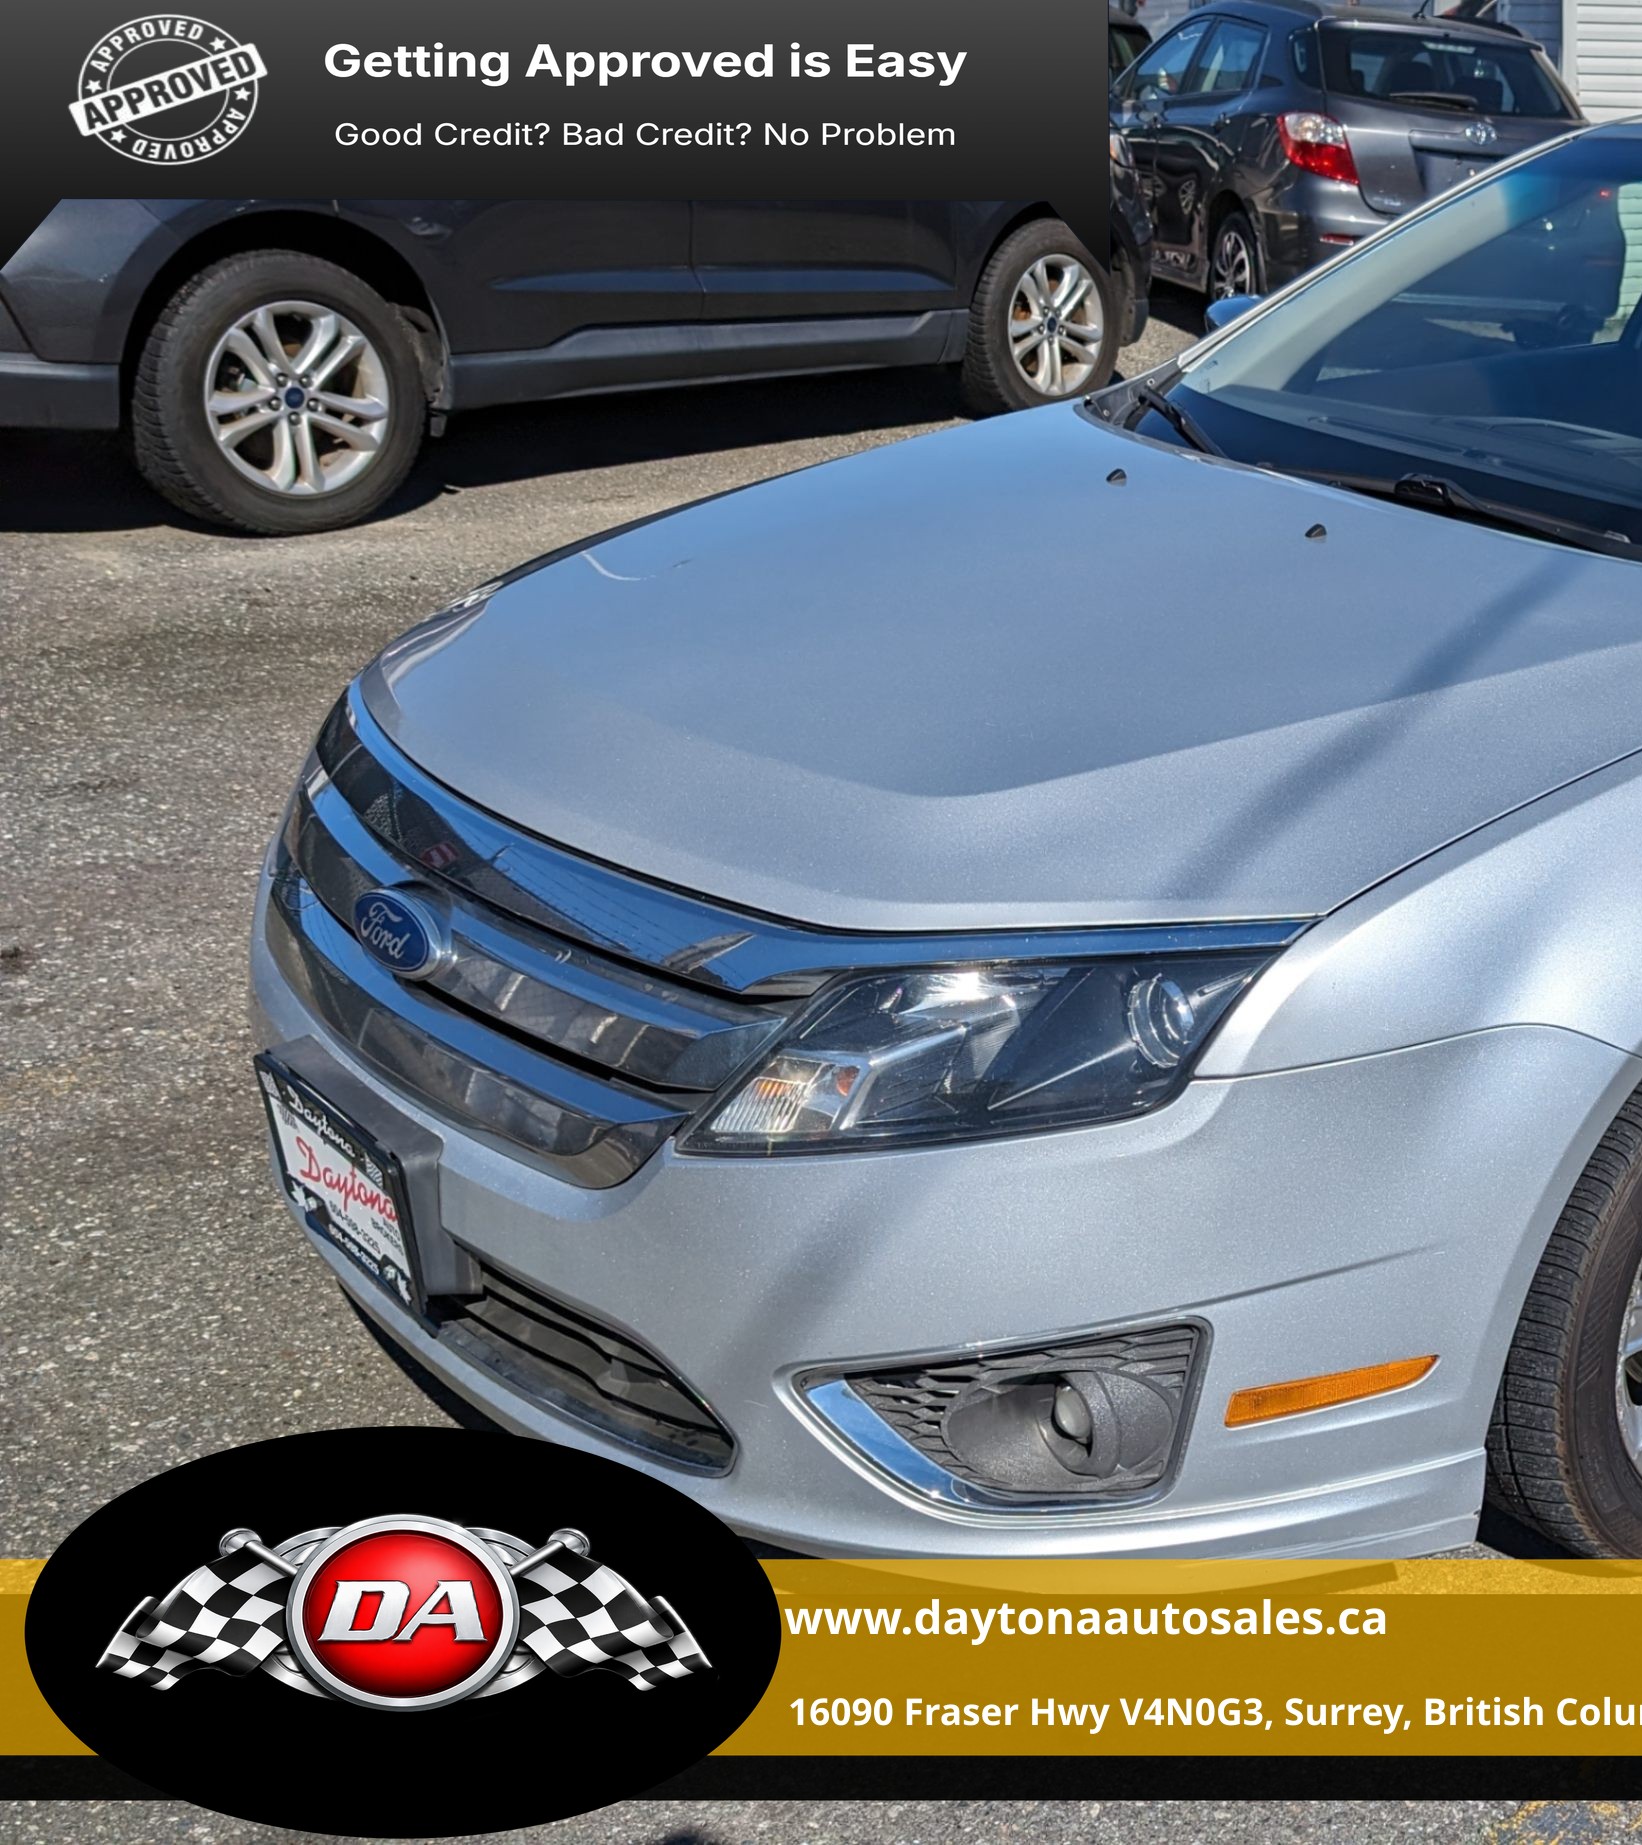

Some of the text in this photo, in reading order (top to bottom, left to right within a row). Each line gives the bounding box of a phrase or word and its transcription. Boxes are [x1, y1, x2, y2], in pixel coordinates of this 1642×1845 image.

[361, 901, 411, 959] Ford
[286, 1084, 356, 1157] Daytona
[296, 1136, 399, 1221] Daytona
